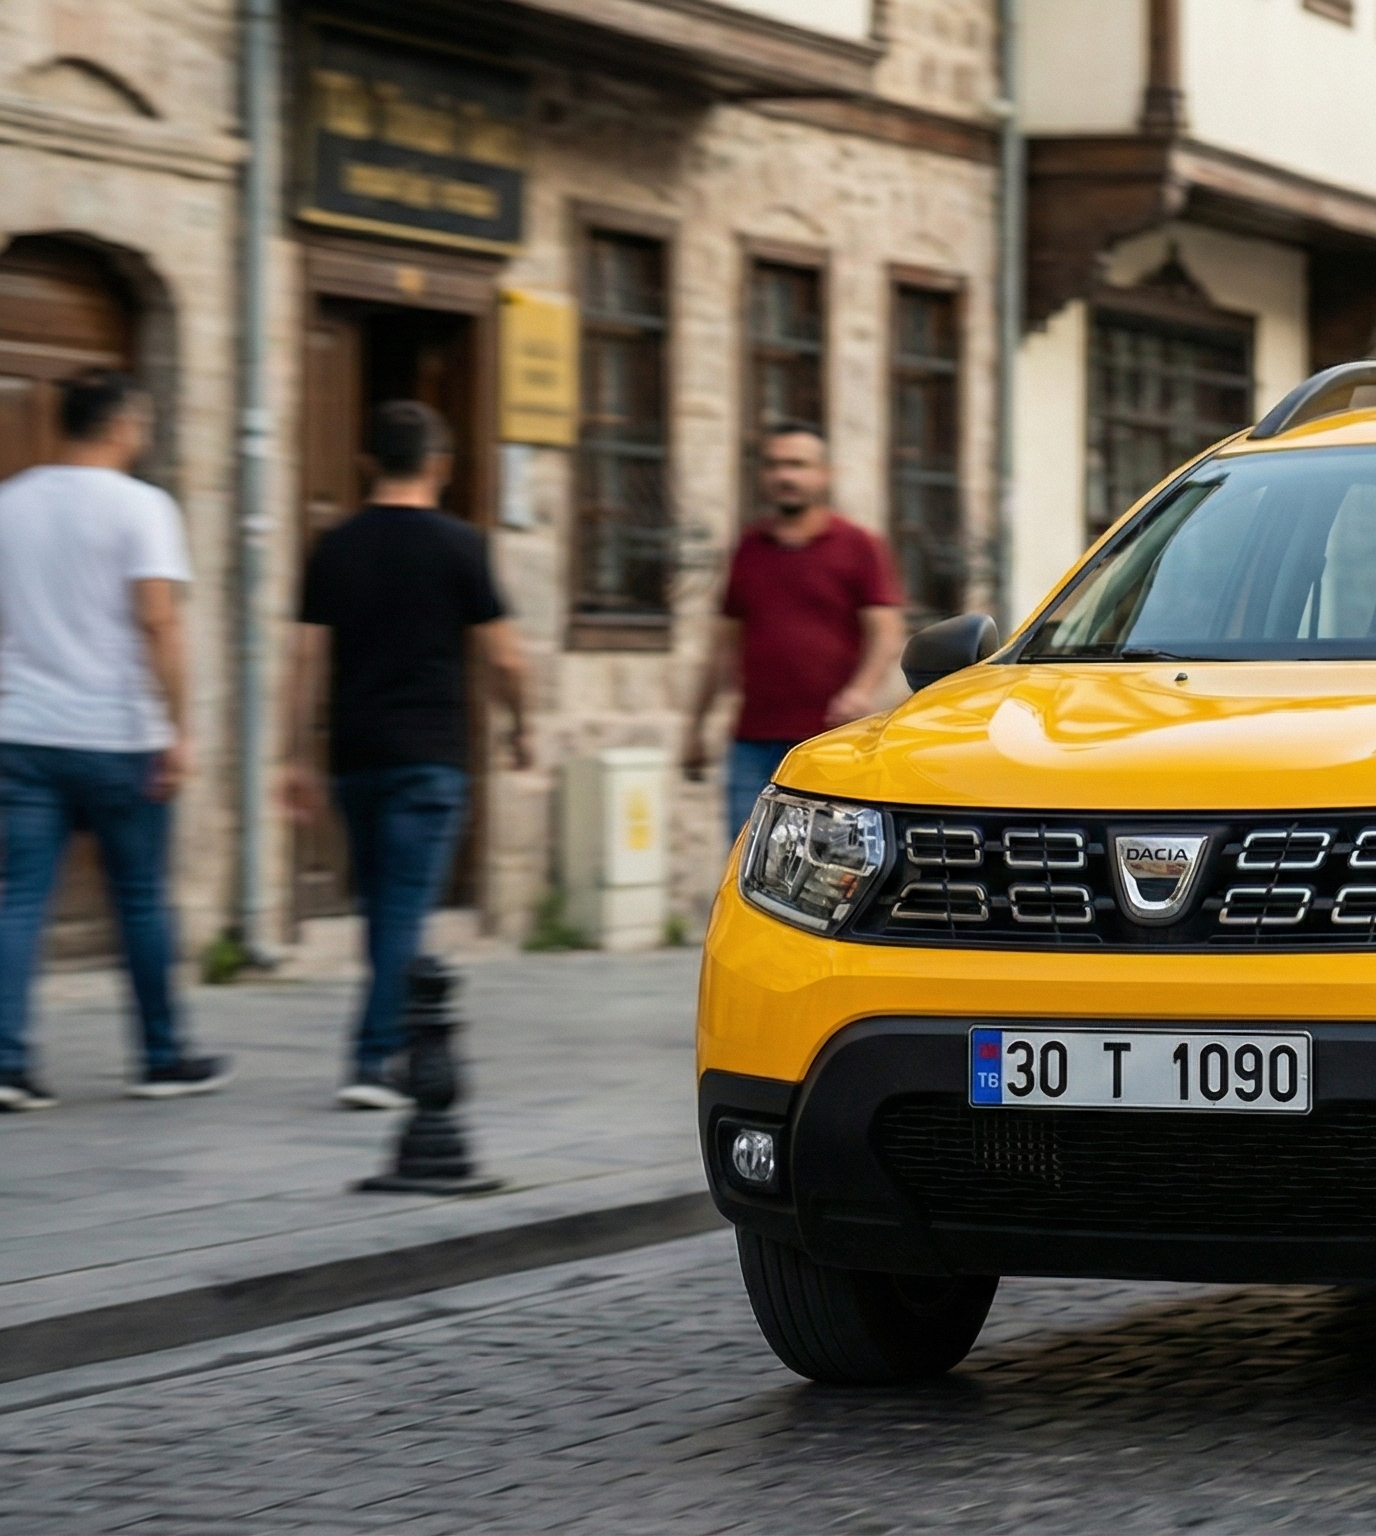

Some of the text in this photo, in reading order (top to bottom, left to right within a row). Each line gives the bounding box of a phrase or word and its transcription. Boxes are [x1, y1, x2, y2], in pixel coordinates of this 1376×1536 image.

[1126, 848, 1188, 861] DACIA
[1006, 1040, 1298, 1103] 30 T 1090
